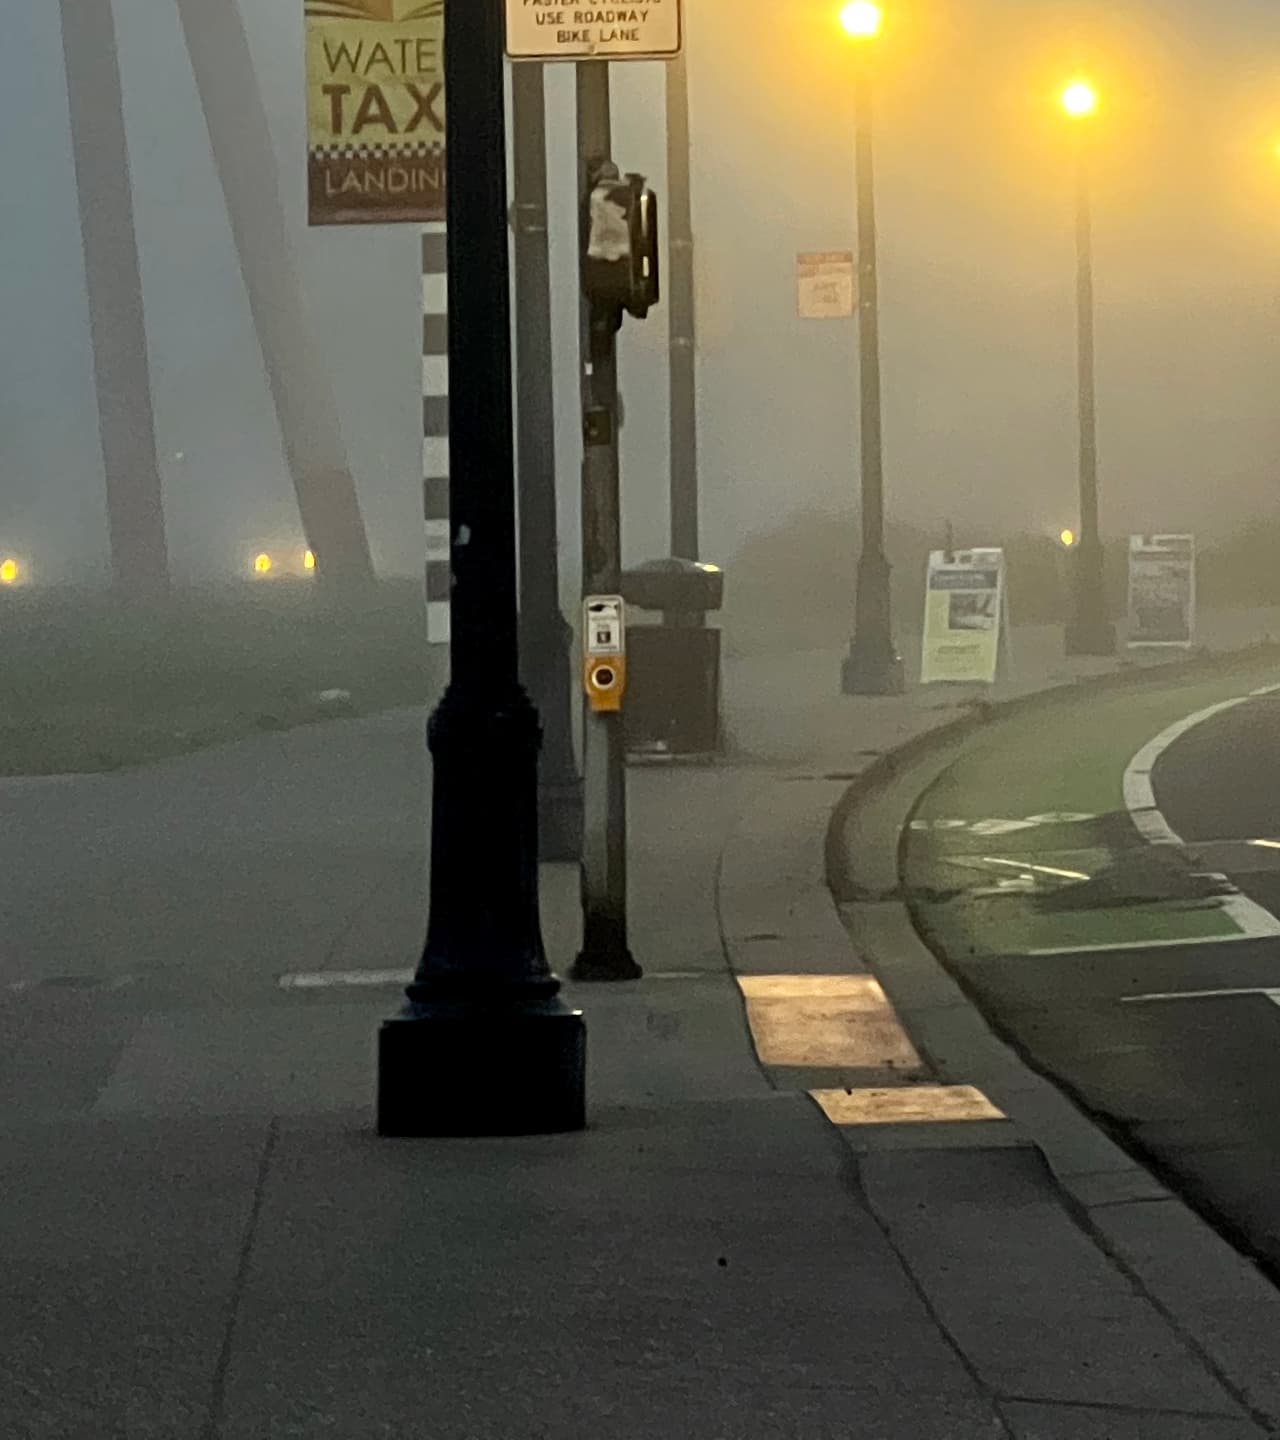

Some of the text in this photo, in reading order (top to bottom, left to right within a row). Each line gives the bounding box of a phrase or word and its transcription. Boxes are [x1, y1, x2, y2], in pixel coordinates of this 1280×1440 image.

[535, 9, 649, 26] USE ROADWAY
[556, 28, 640, 44] BIKE LANE
[322, 37, 437, 76] WATE
[321, 81, 444, 136] TAX
[325, 166, 446, 195] LANDIN
